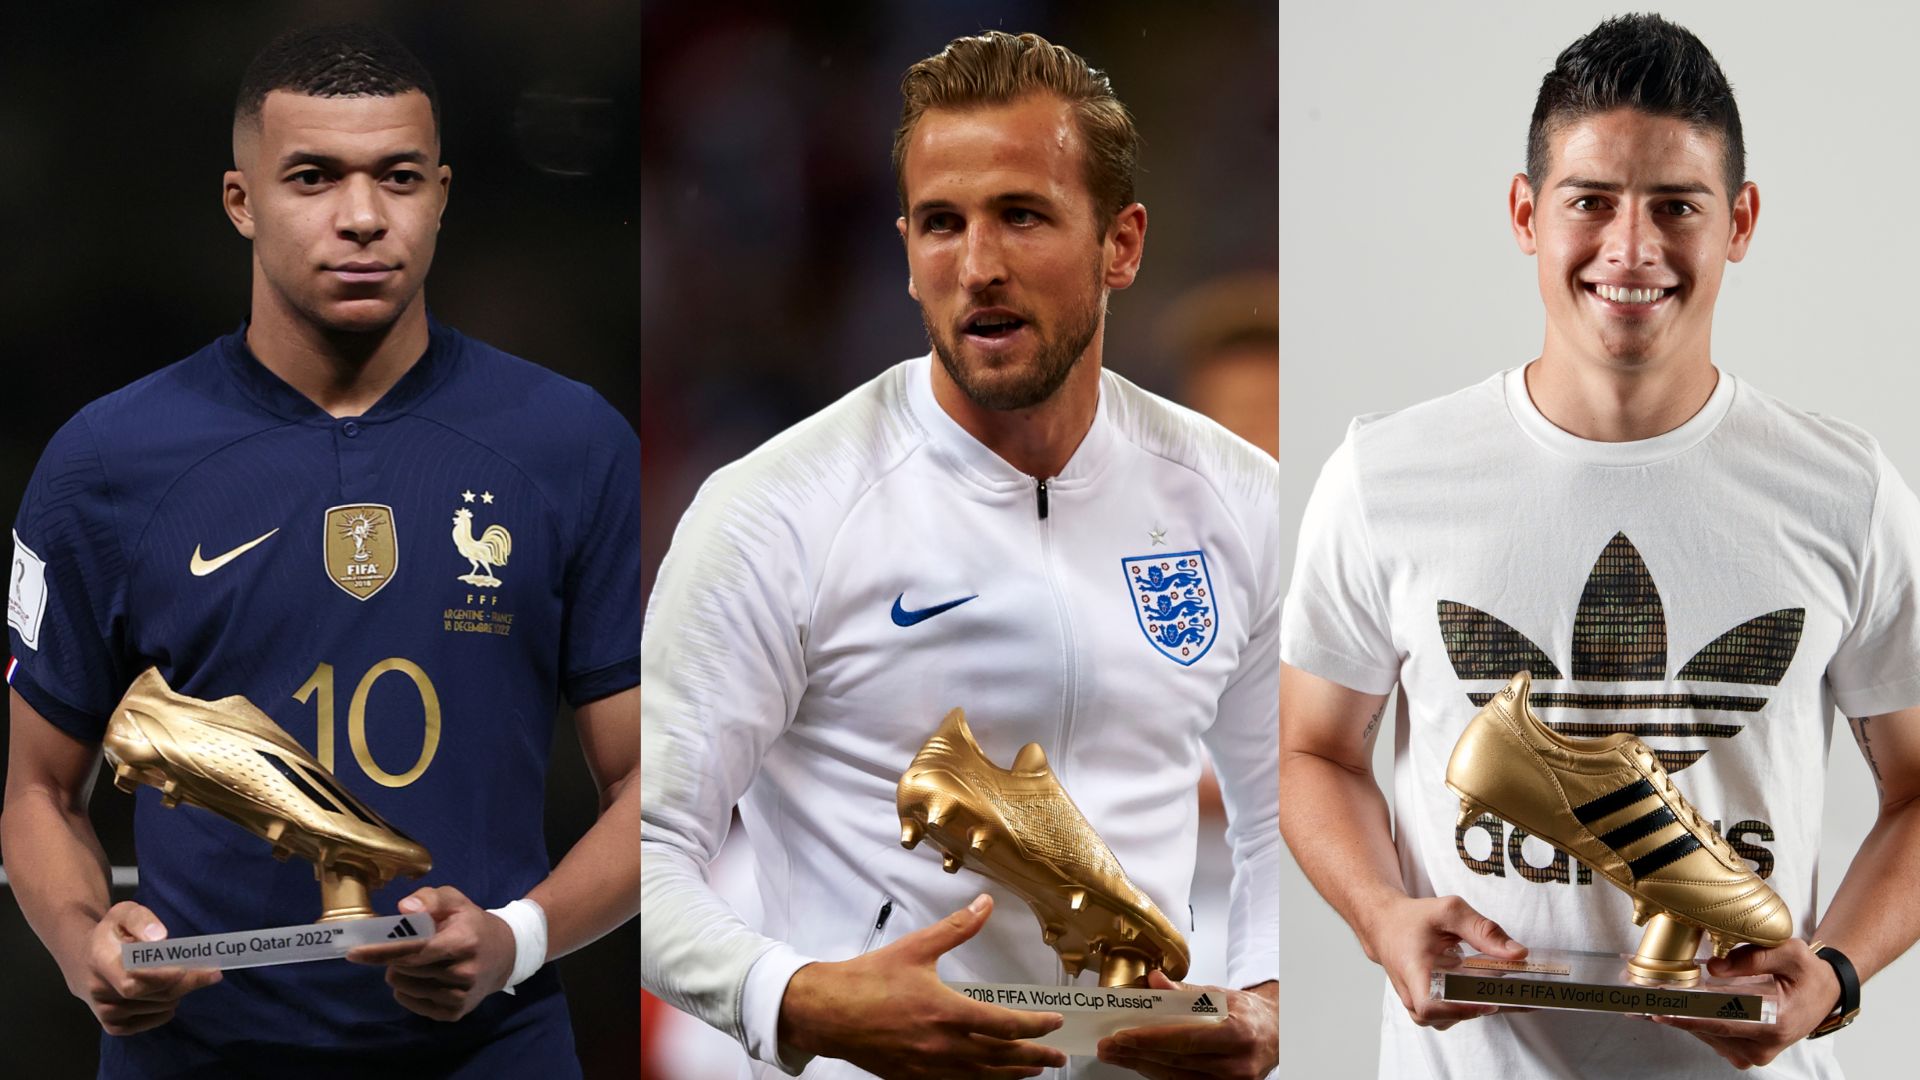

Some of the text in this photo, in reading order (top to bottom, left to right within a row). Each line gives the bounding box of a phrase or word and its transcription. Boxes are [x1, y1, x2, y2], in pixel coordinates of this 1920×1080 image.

[347, 563, 377, 575] FIFA
[291, 657, 441, 788] 10
[132, 950, 164, 965] FIFA
[166, 942, 212, 961] World
[215, 940, 247, 958] Cup
[250, 936, 292, 953] Qatar
[997, 989, 1028, 1006] FIFA
[1030, 991, 1072, 1008] World
[1074, 992, 1104, 1011] Cup
[1476, 980, 1515, 998] 2014
[1520, 983, 1556, 1000] FIFA
[1560, 986, 1605, 1004] World
[1609, 989, 1641, 1009] Cup
[1191, 1003, 1218, 1013] adidas
[1715, 1009, 1749, 1019] adidas
